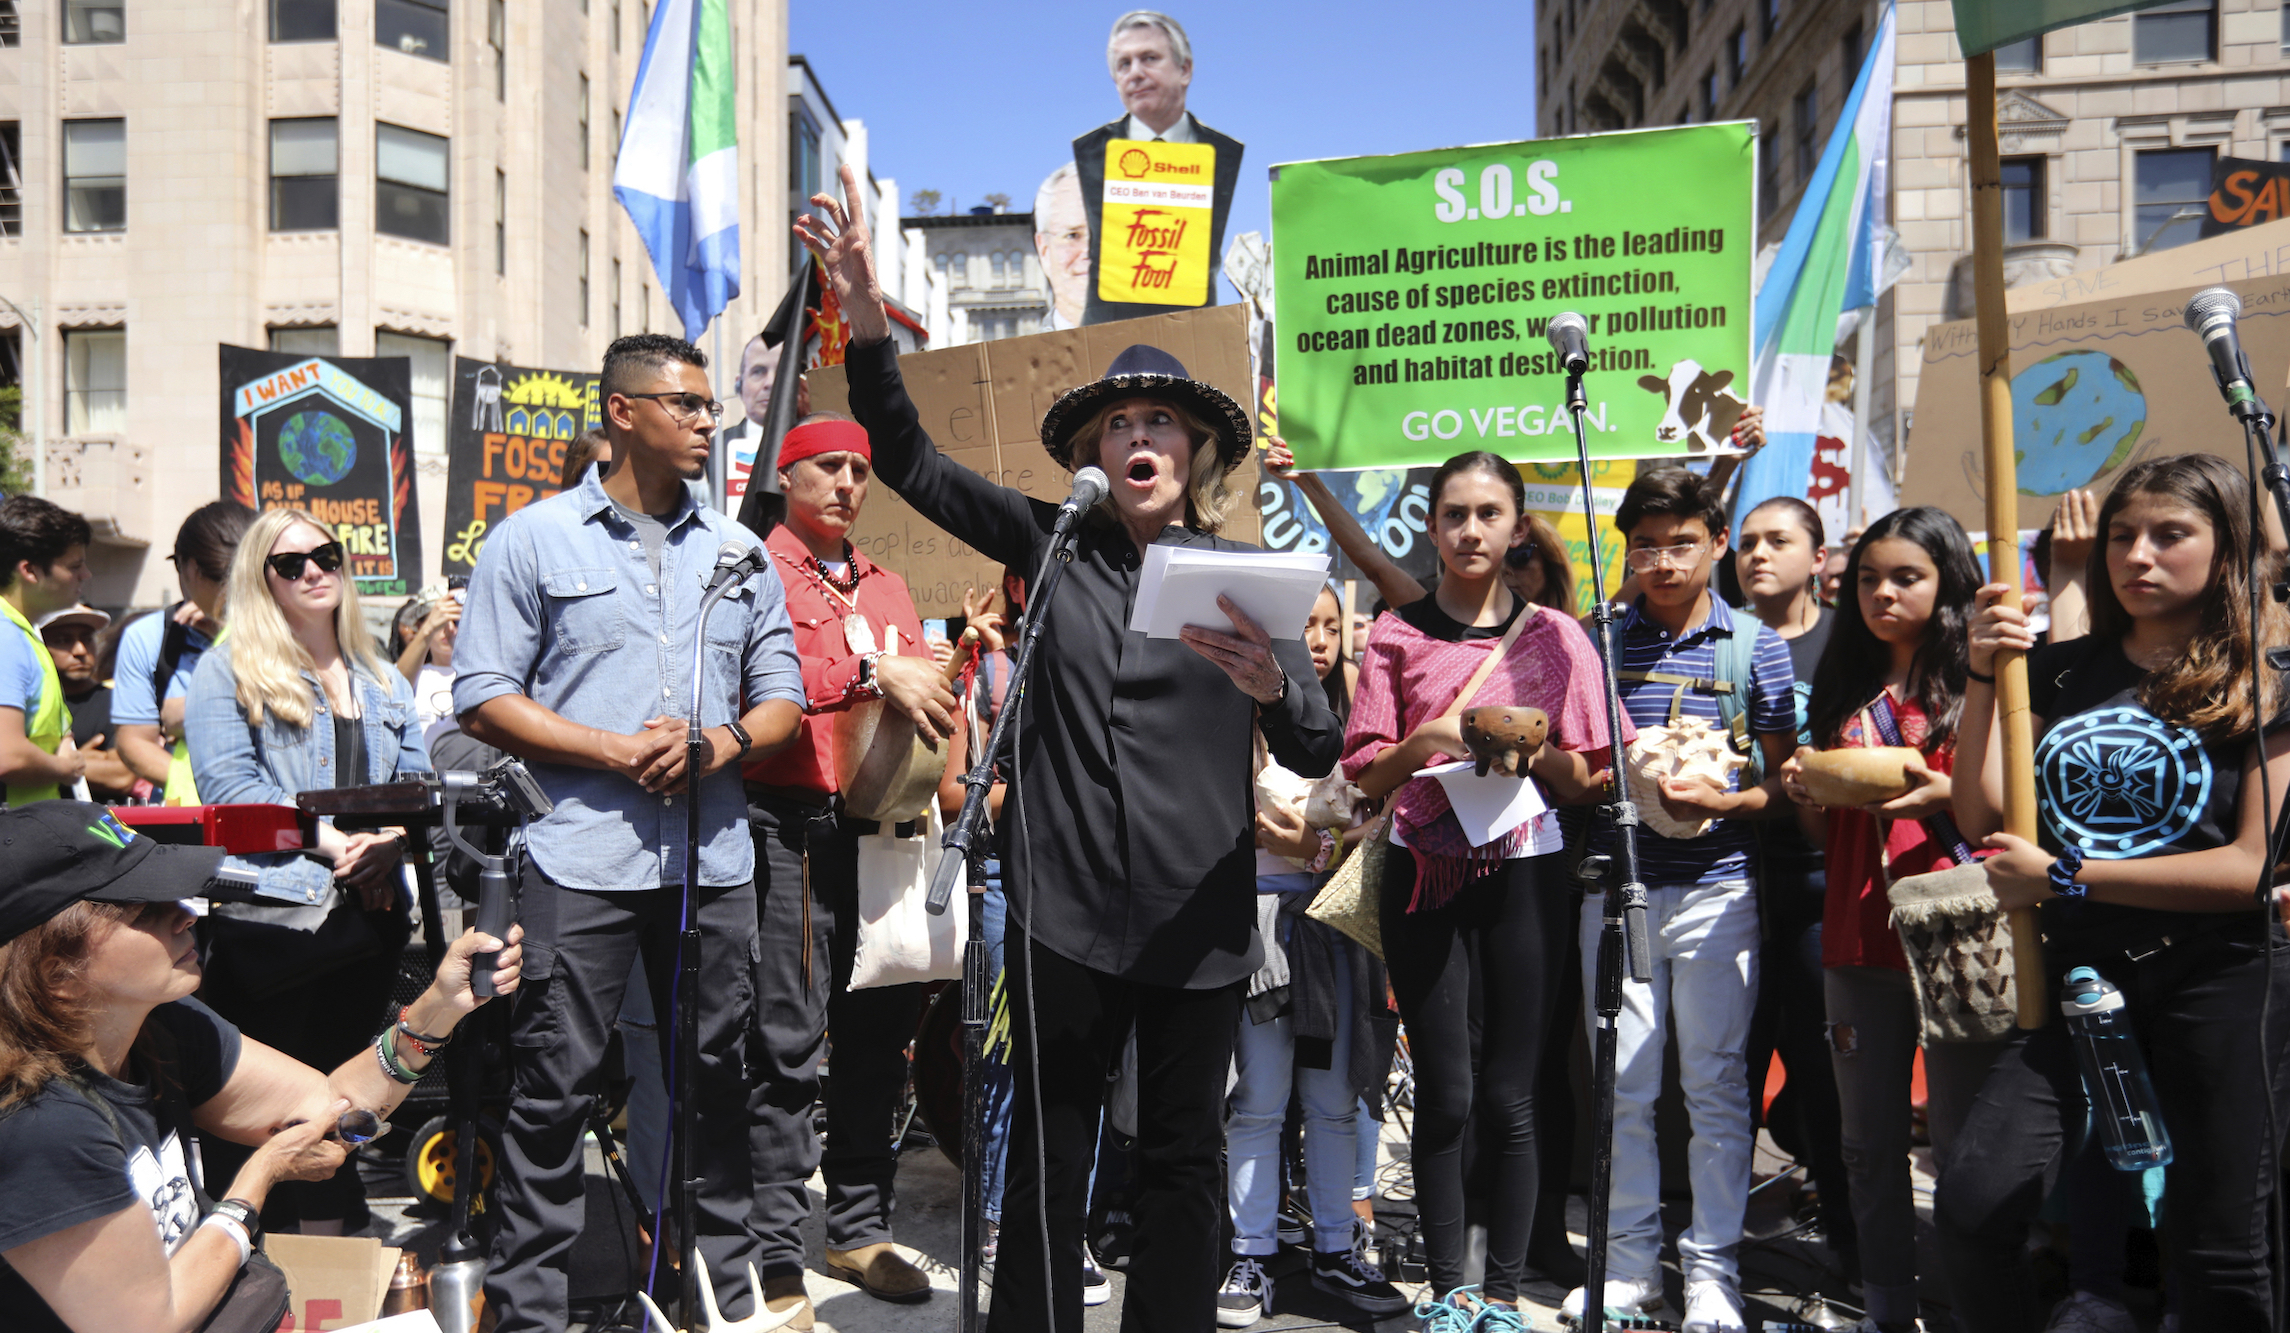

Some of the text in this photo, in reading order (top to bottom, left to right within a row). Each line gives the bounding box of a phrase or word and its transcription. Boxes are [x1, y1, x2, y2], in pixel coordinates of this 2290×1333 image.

[1153, 162, 1200, 175] Shell
[1110, 186, 1130, 197] CEO
[1132, 188, 1149, 198] Ben
[1170, 190, 1207, 201] Beurden
[1434, 159, 1572, 223] S.O.S.
[1126, 209, 1187, 250] Fossil
[1131, 250, 1178, 291] Fool
[1305, 226, 1724, 280] Animal Agriculture is the leading
[1326, 268, 1680, 315] cause of species extinction,
[2043, 269, 2120, 308] SAVE
[1296, 327, 1370, 353] ocean
[1376, 319, 1436, 347] dead
[1442, 319, 1520, 344] zones,
[1607, 303, 1726, 336] pollution
[1930, 326, 1978, 351] With
[2038, 311, 2097, 335] Hands
[2105, 308, 2128, 328] I
[2142, 305, 2185, 322] Sav
[2243, 286, 2290, 309] Eart
[1353, 346, 1656, 386] and habitat destrction.
[243, 388, 254, 408] I
[256, 362, 321, 401] WANT
[329, 370, 357, 400] YOU
[359, 387, 376, 411] TO
[1402, 402, 1617, 441] GO VEGAN.
[482, 432, 568, 485] FOSS
[261, 481, 305, 500] AS IF
[1524, 490, 1545, 503] EO
[1548, 492, 1571, 505] Bob
[310, 498, 382, 525] HOUSE
[338, 523, 389, 556] FIRE
[355, 559, 394, 577] IT IS
